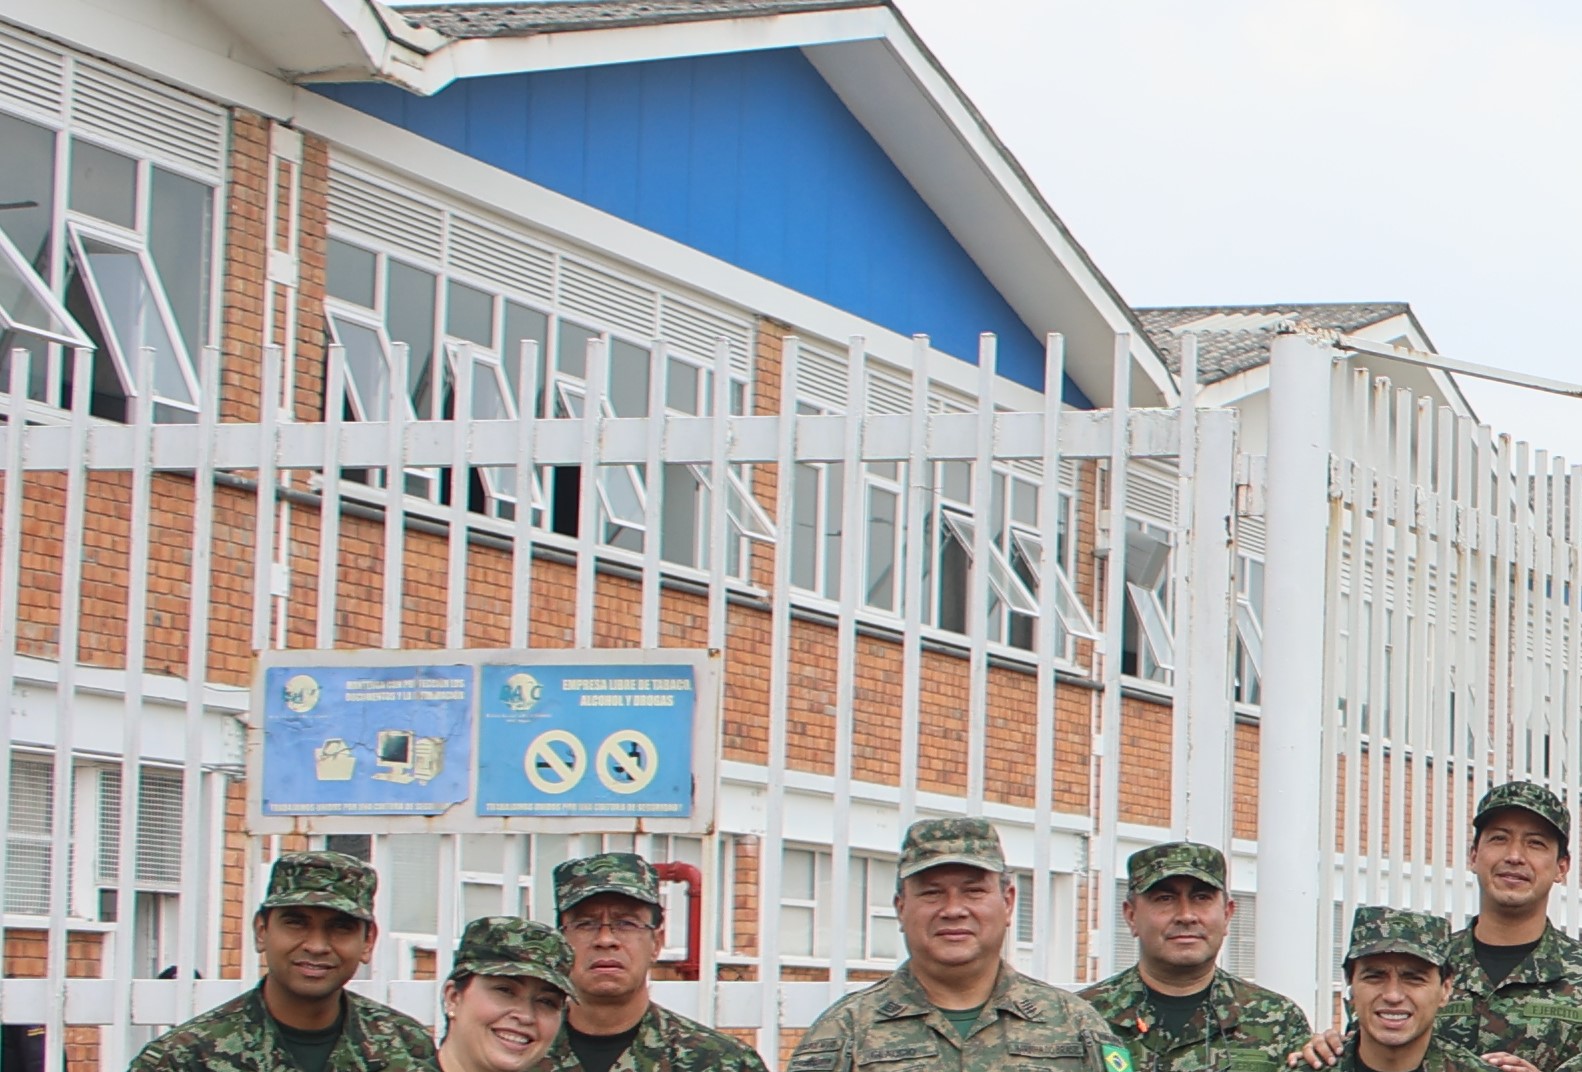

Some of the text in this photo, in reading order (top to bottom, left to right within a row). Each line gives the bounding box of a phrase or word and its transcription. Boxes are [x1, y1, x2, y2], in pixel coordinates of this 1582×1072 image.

[562, 679, 606, 690] EMPRESA
[609, 679, 636, 690] LIBRE
[638, 679, 651, 690] DE
[580, 695, 674, 706] ALCOHOL Y DROGAS
[1533, 1004, 1580, 1020] EJERCITO
